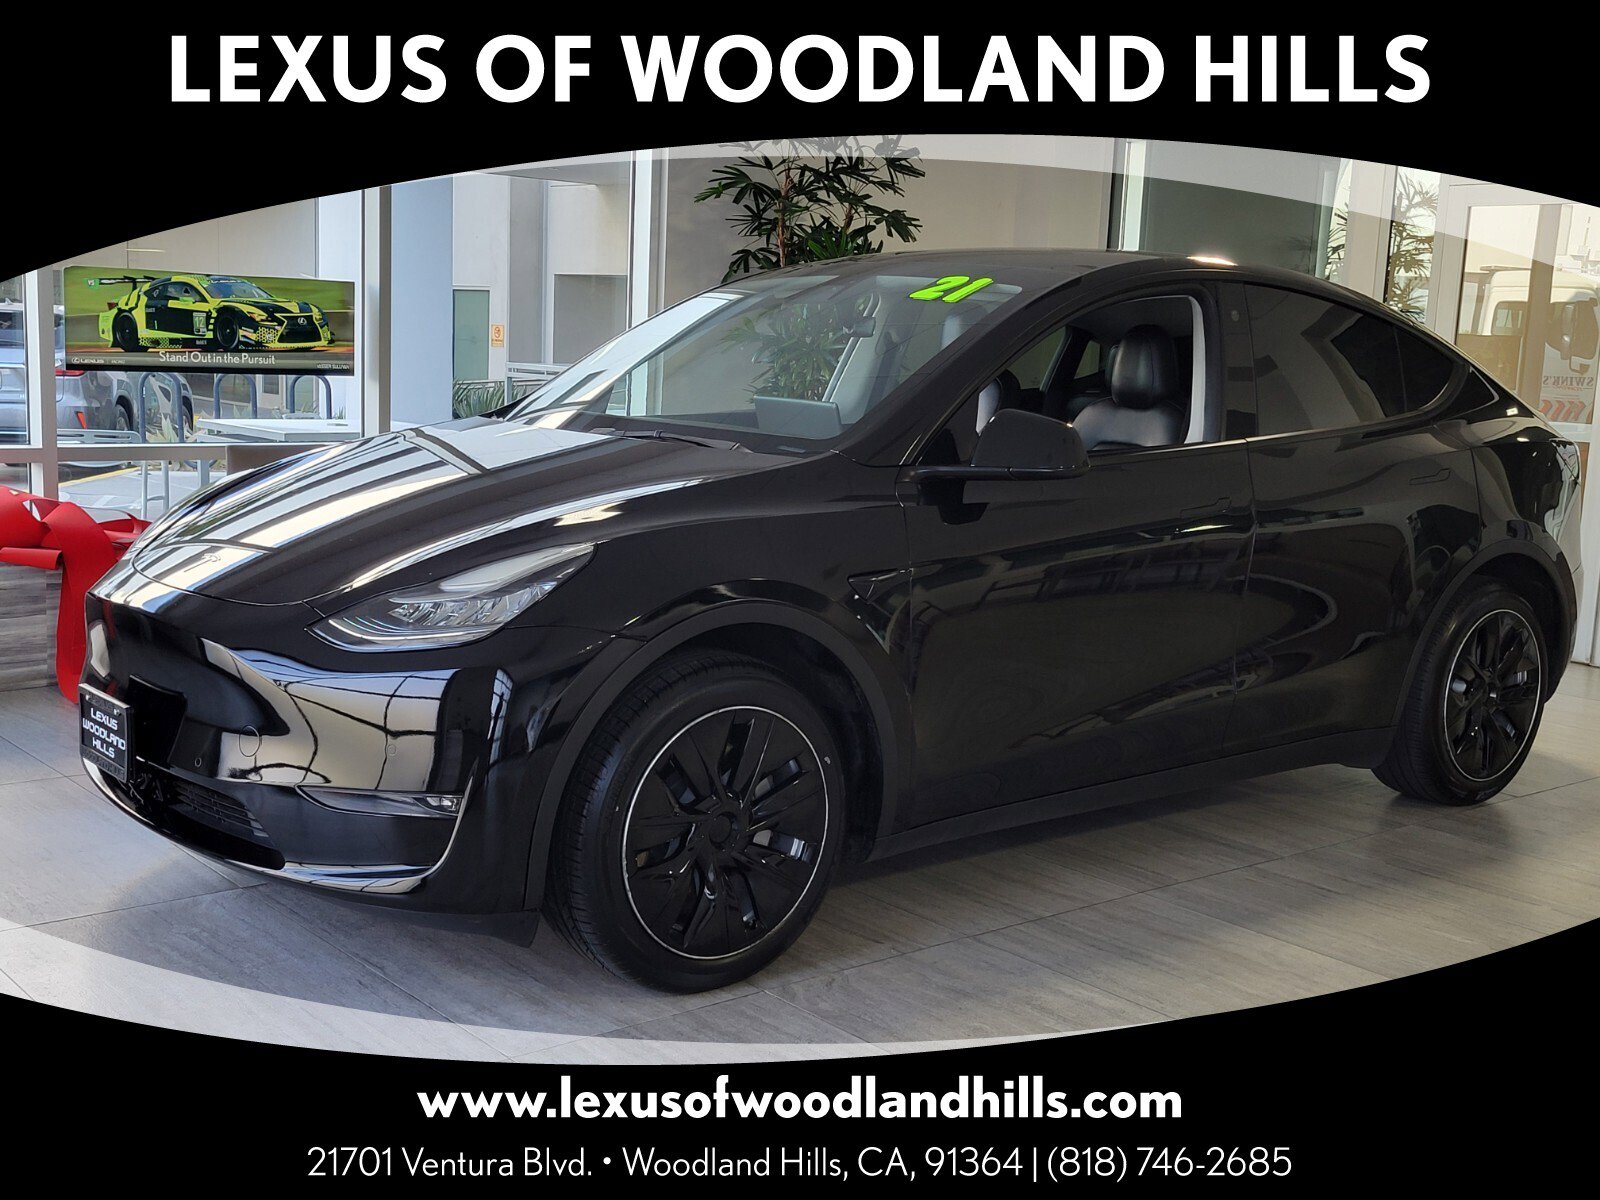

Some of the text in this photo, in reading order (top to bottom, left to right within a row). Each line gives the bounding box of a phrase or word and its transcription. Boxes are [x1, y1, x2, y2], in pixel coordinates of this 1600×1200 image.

[909, 275, 994, 303] 21
[194, 316, 206, 329] 12
[158, 350, 276, 365] Stand Out in the Pursuit
[90, 707, 118, 730] LEXUS
[82, 718, 126, 751] WOODLAND
[92, 736, 115, 758] HILLS
